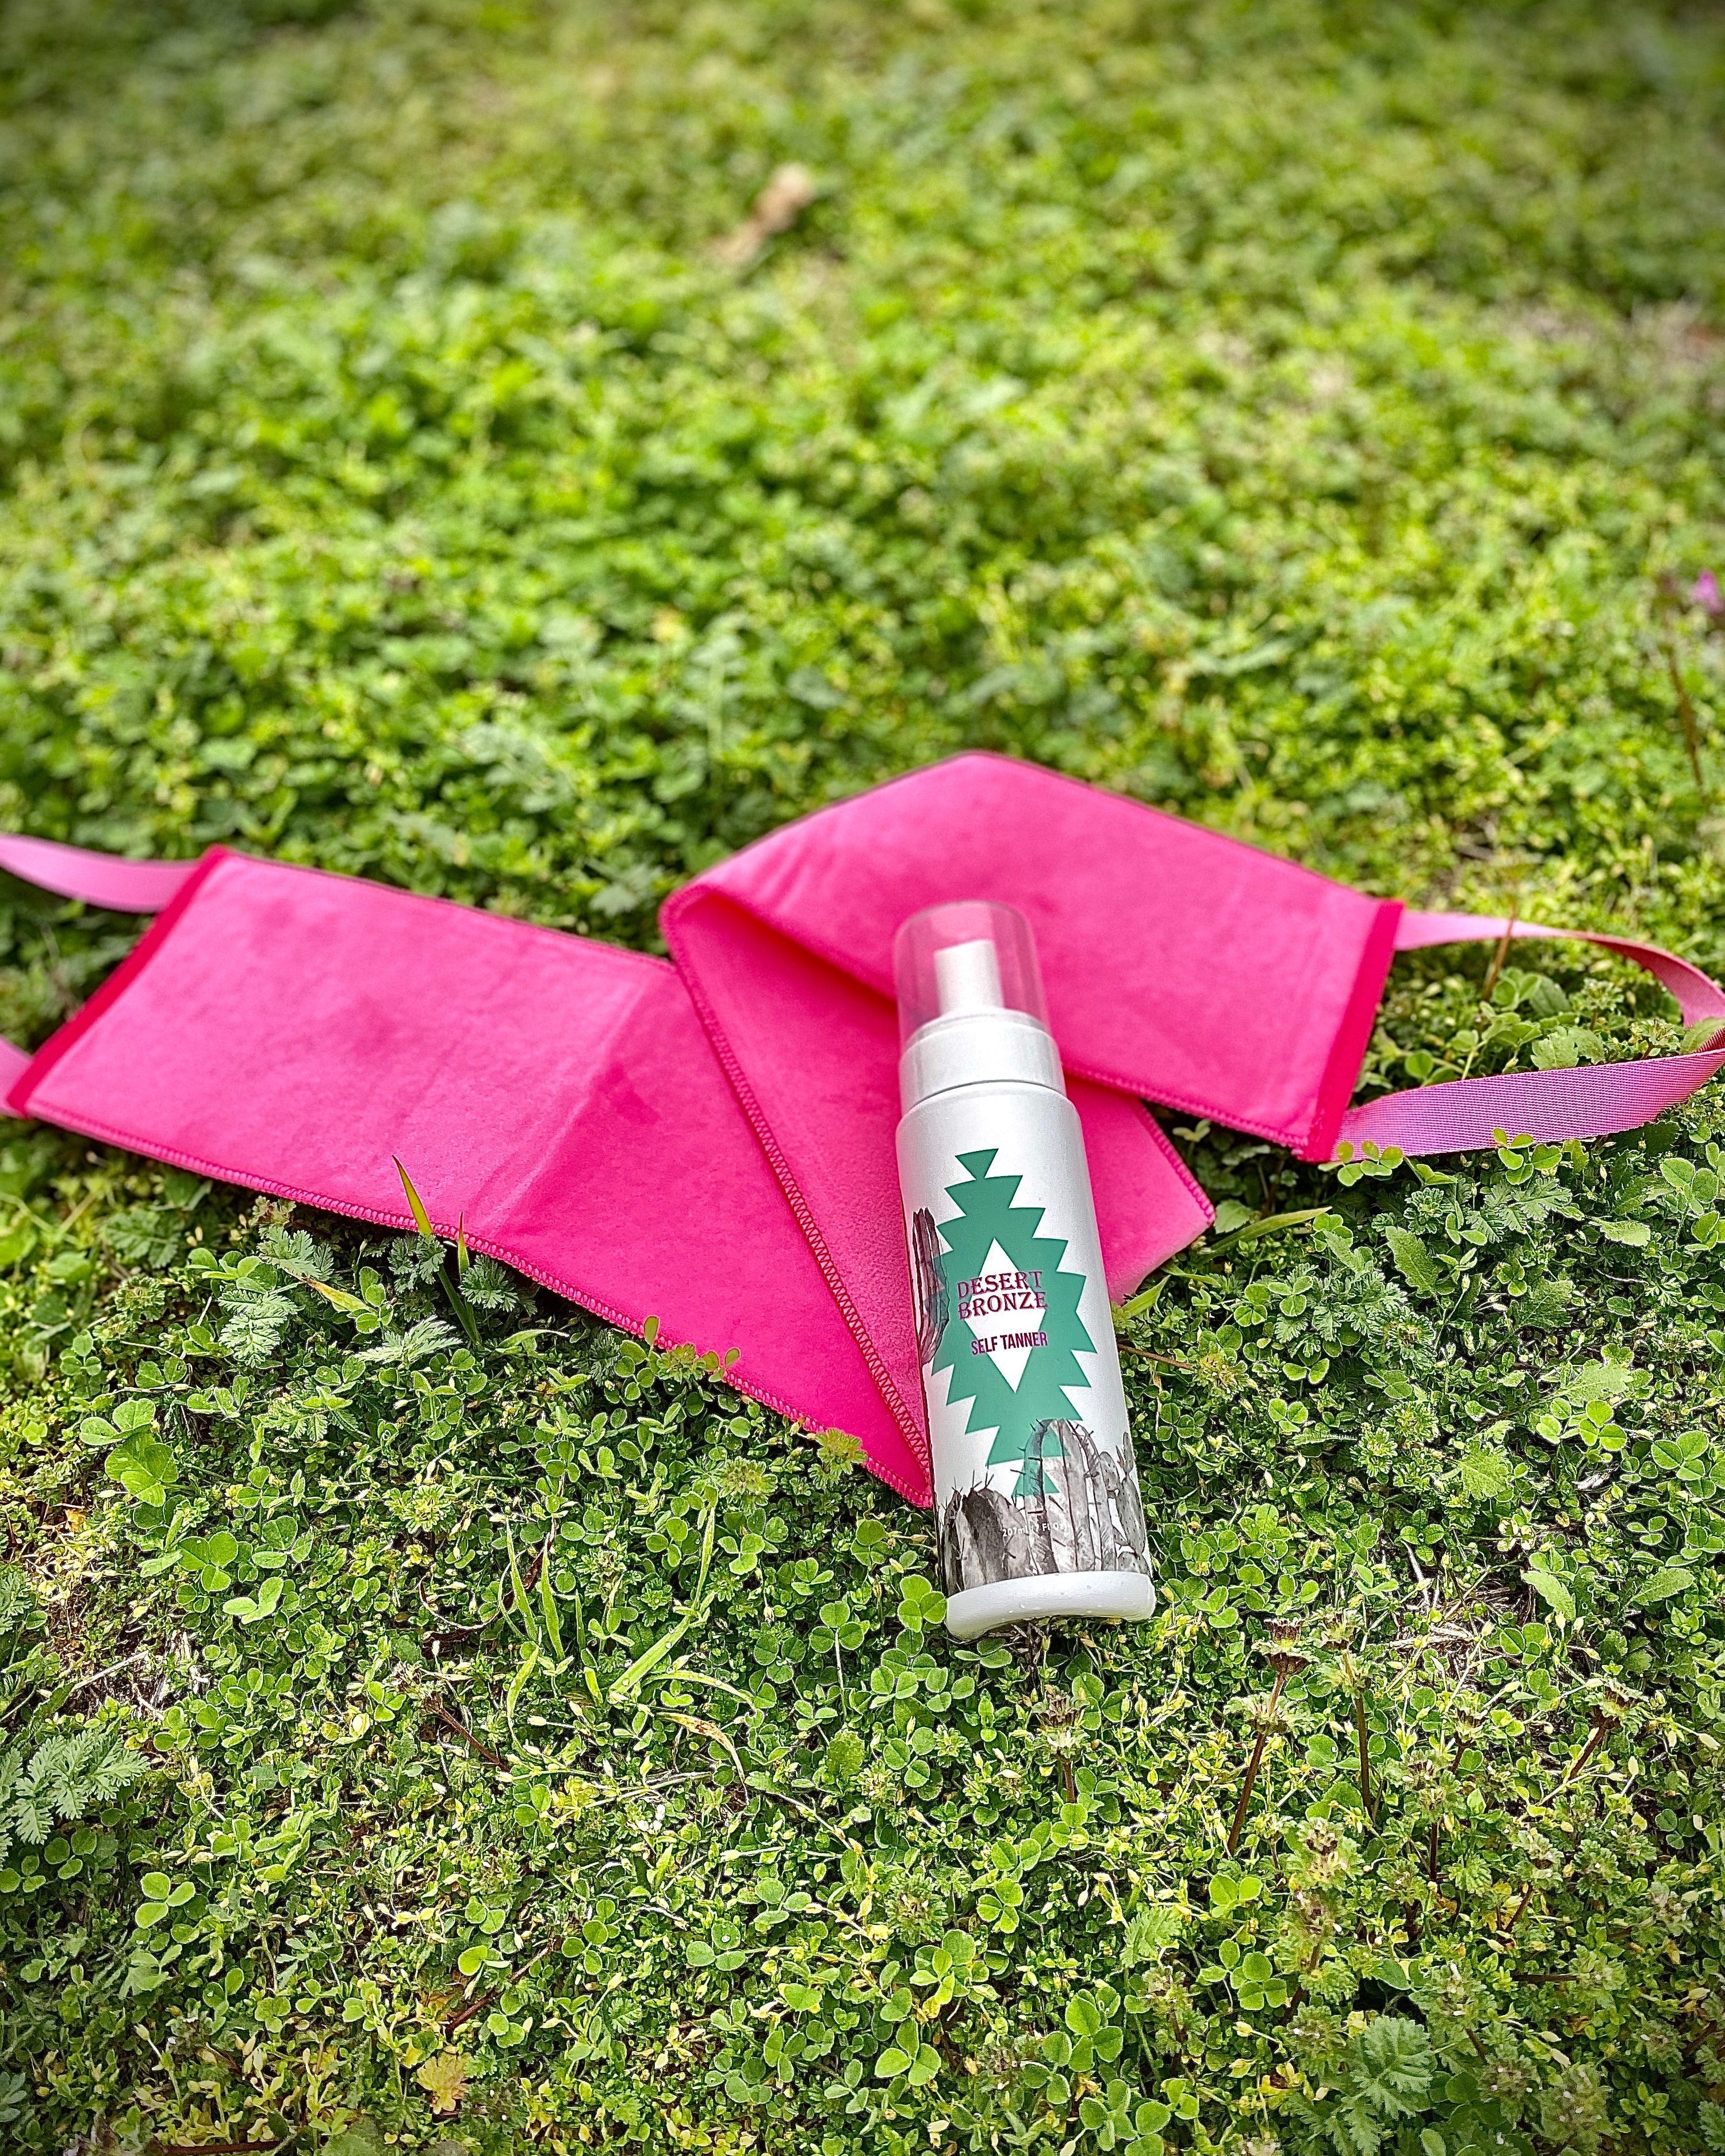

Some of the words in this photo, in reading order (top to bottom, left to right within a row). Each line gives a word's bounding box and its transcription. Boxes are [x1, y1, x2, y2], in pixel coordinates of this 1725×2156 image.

[957, 1271, 1042, 1299] DESERT
[958, 1291, 1048, 1319] BRONZE
[971, 1336, 998, 1355] SELF
[1000, 1332, 1048, 1349] TANNER
